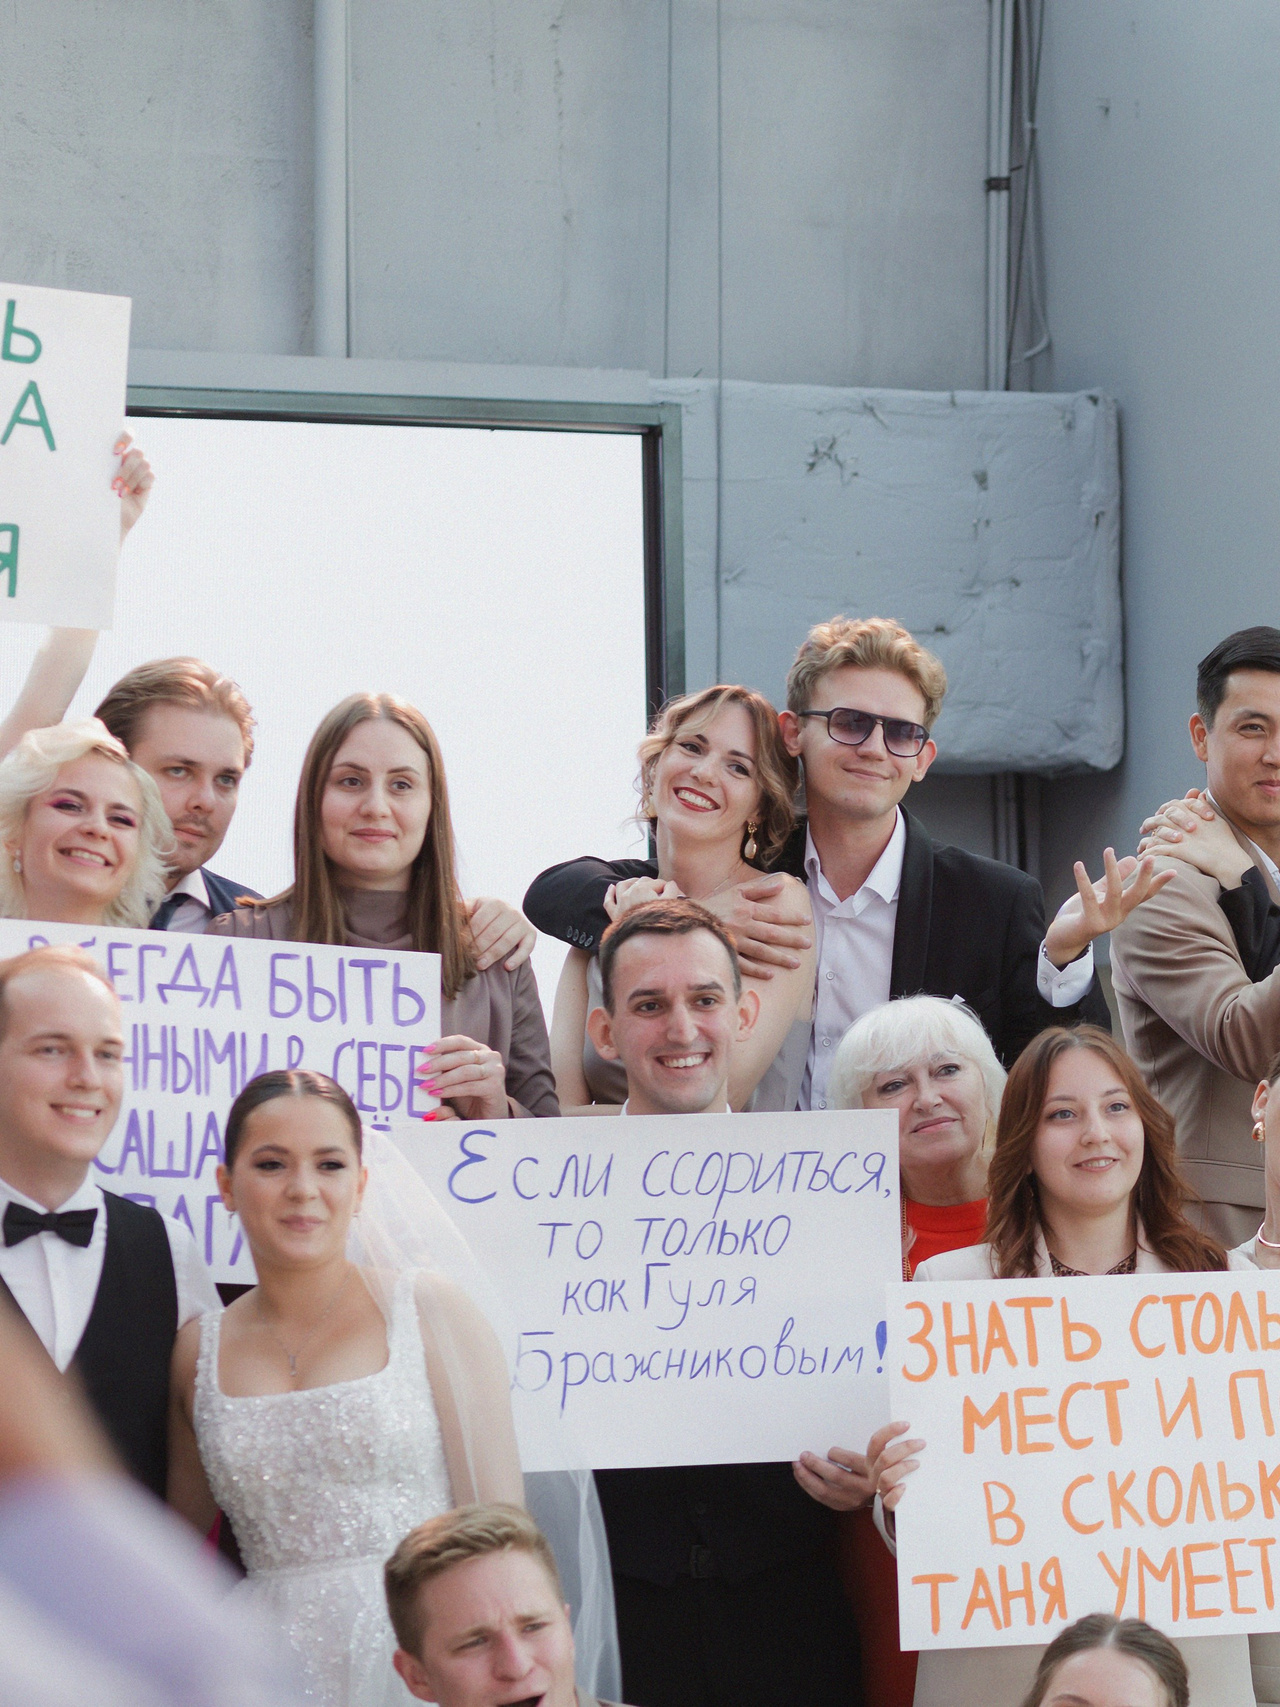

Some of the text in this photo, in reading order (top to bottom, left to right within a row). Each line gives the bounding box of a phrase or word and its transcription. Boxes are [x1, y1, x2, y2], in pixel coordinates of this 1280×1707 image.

[28, 935, 426, 1027] ЕГДА БЫТЬ
[332, 1037, 427, 1119] СЕБЕ
[447, 1129, 891, 1218] Если ссориться,
[538, 1214, 792, 1263] то только
[562, 1262, 757, 1331] как Гуля
[513, 1317, 887, 1416] Бражниковым!
[902, 1297, 1101, 1382] ЗНАТЬ
[963, 1379, 1129, 1454] МЕСТ
[1155, 1378, 1202, 1438] И
[983, 1481, 1025, 1546] В
[912, 1557, 1067, 1634] ТАНЯ
[1098, 1538, 1276, 1621] УМЕЕТ
